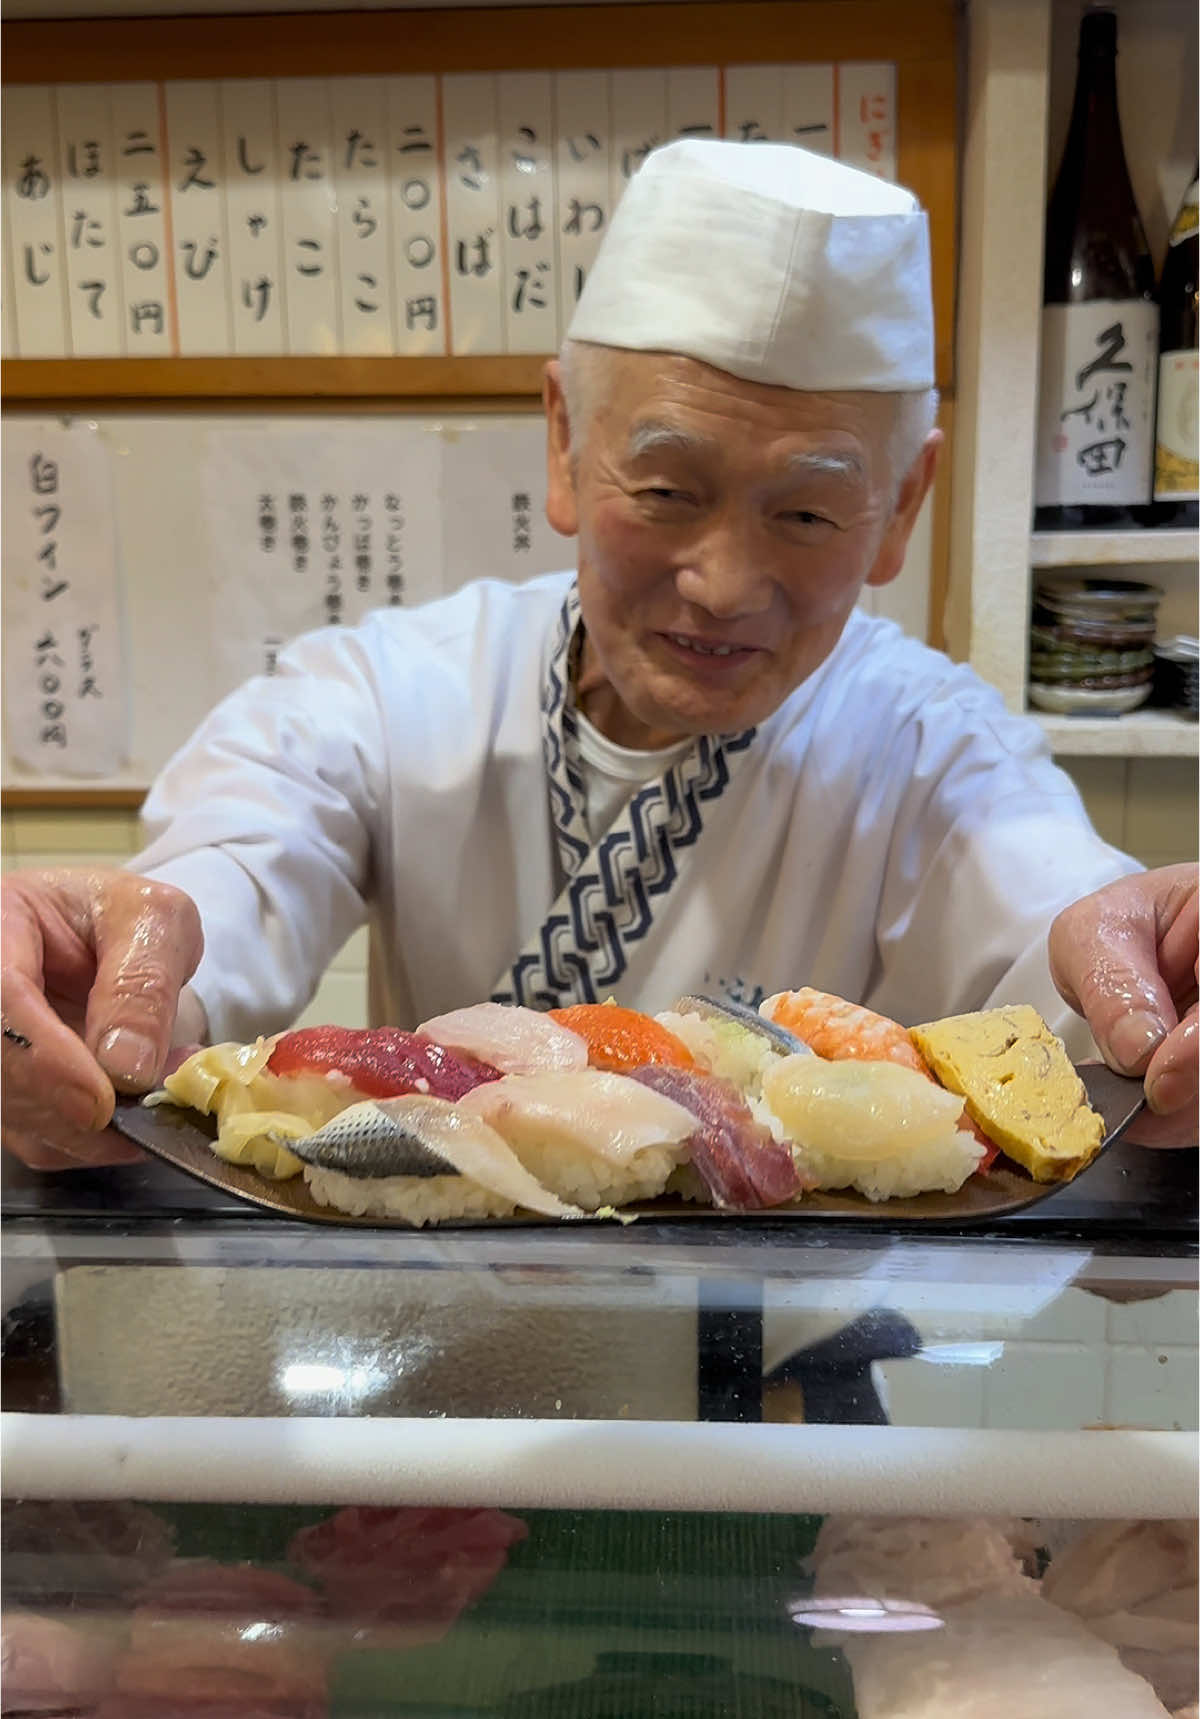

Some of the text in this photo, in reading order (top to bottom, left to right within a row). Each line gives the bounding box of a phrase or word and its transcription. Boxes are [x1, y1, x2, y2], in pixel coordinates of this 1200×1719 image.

[15, 153, 54, 286] あじ
[177, 148, 218, 281] えび
[289, 141, 323, 277] たこ
[455, 144, 496, 277] さば
[507, 125, 552, 313] こはだ
[860, 94, 887, 178] にぎ
[67, 140, 106, 319] ほたて
[123, 131, 165, 335] 二五〇円
[237, 136, 274, 322] しゃけ
[344, 127, 379, 314] たらこ
[396, 124, 440, 332] 二〇〇円
[1060, 321, 1134, 476] 久保田
